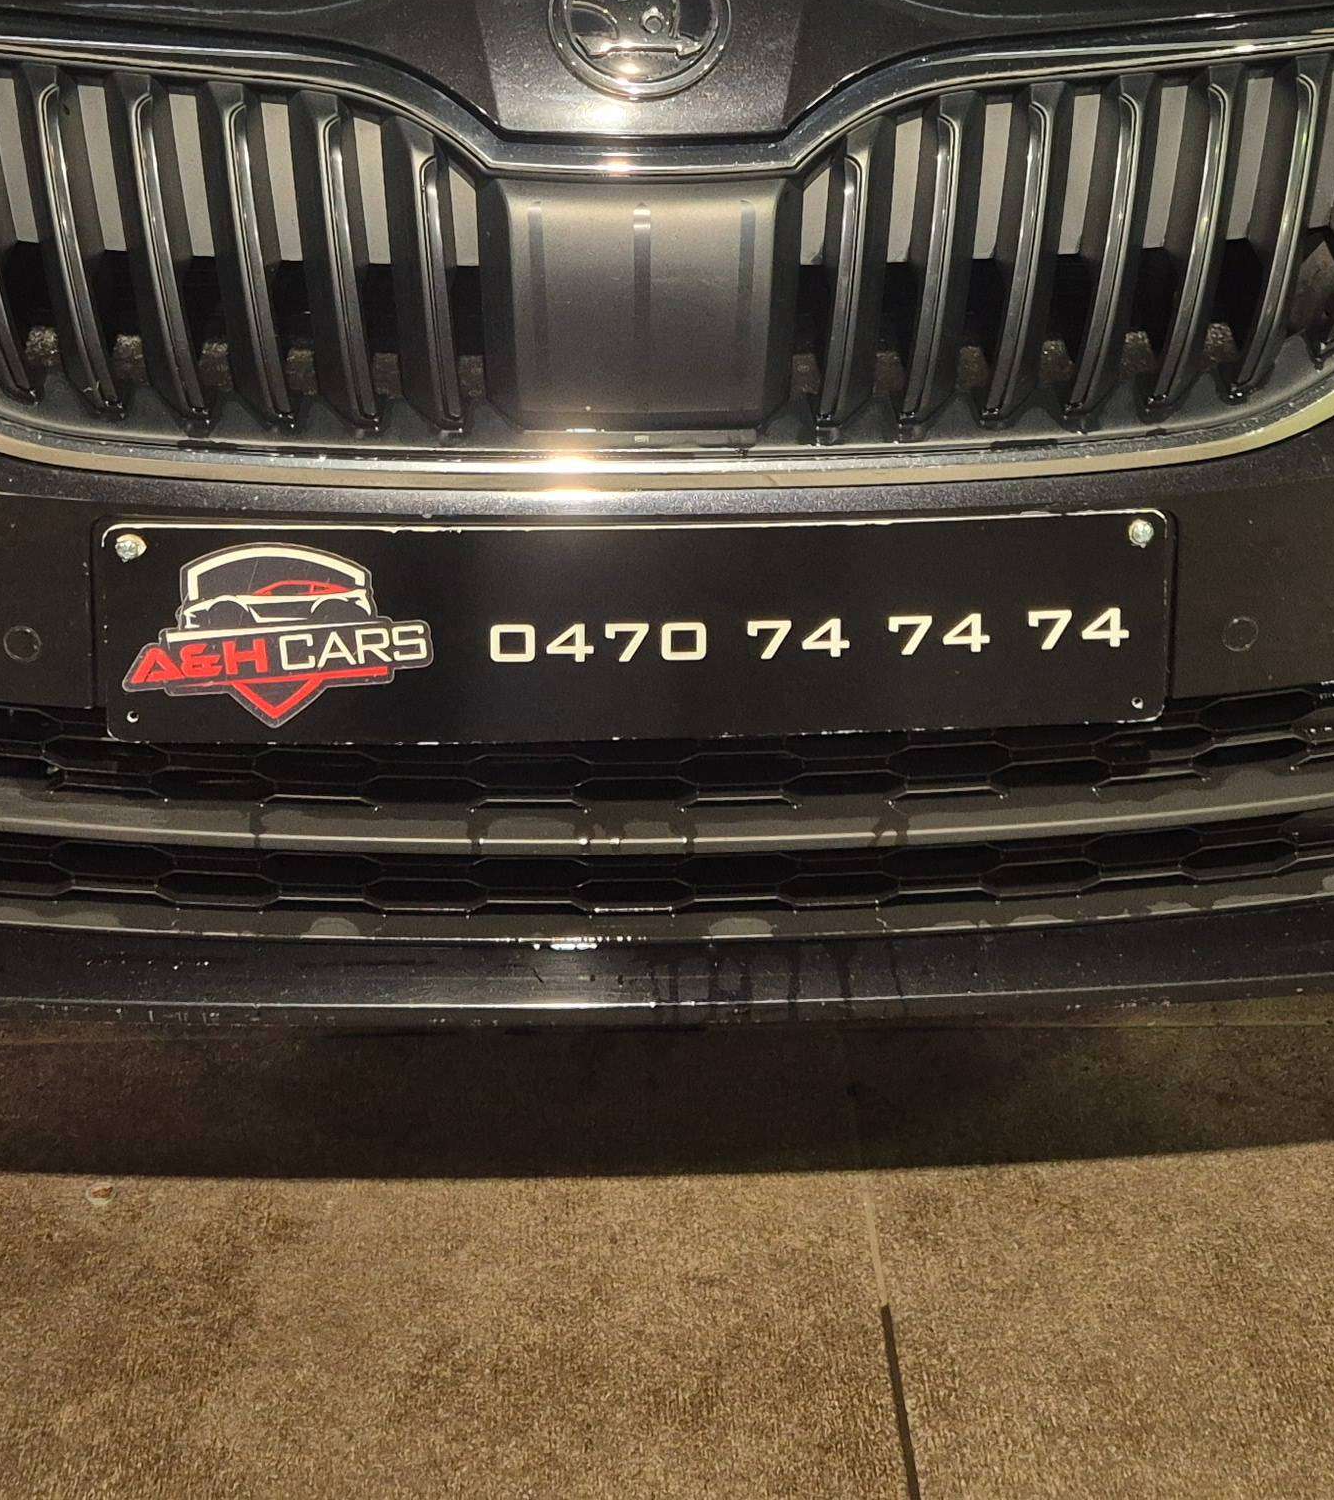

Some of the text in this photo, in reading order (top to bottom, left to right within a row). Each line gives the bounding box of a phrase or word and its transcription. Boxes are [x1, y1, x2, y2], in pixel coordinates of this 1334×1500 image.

[132, 623, 428, 685] A&H CARS
[490, 607, 1130, 663] 0470 74 74 74
